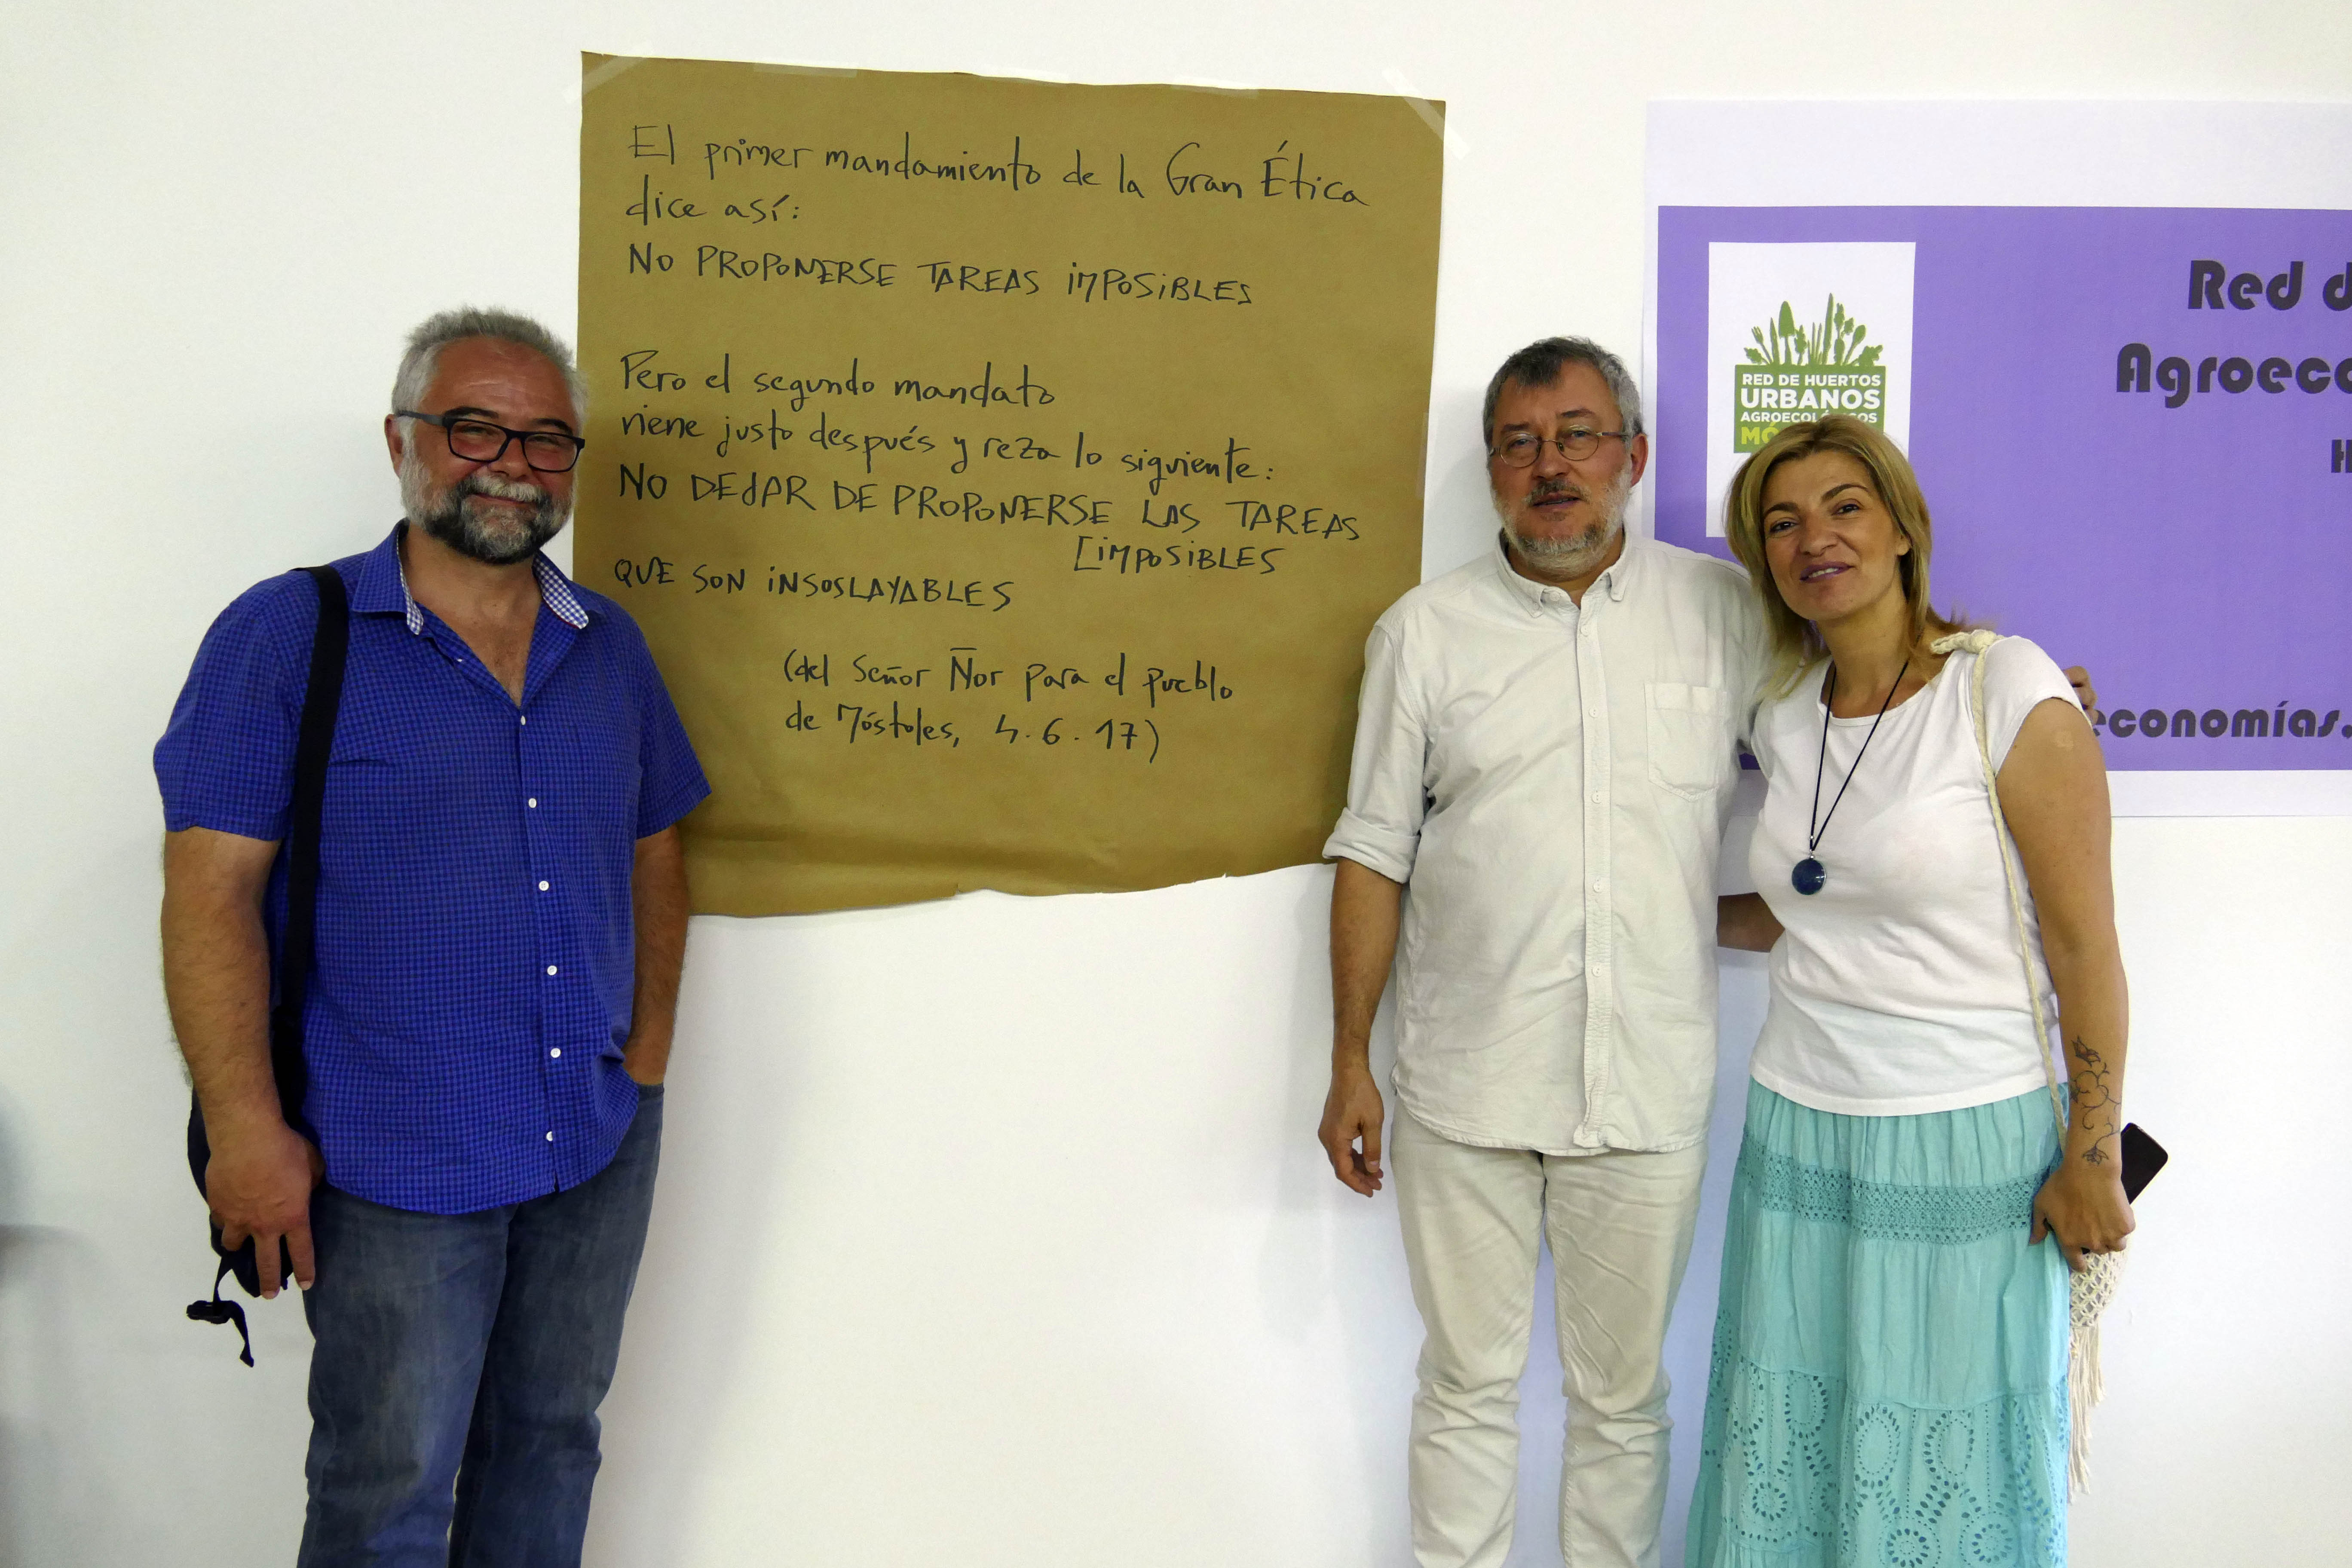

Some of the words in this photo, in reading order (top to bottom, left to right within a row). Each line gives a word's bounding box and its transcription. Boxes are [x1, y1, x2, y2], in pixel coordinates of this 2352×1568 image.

[628, 123, 675, 165] El
[704, 138, 814, 181] primer
[825, 131, 1041, 192] mandamiento
[1062, 149, 1102, 187] de
[1119, 153, 1145, 199] la
[1166, 141, 1243, 199] Gran
[1260, 139, 1370, 207] Ética
[625, 174, 706, 227] dice
[724, 194, 799, 224] así:
[629, 242, 674, 275] NO
[697, 245, 897, 288] PROPONERSE
[916, 261, 1040, 296] TAREAS
[2188, 260, 2304, 310] Red
[2322, 261, 2352, 311] d
[619, 349, 686, 392] Pero
[705, 352, 731, 394] el
[753, 357, 875, 413] segundo
[894, 361, 1055, 408] mandato
[1741, 388, 1880, 409] URBANOS
[1742, 374, 1774, 386] RED
[1778, 374, 1800, 386] DE
[1805, 374, 1881, 386] HUERTOS
[2116, 343, 2352, 409] Agroec
[1741, 410, 1877, 423] AGROECOLOS
[622, 404, 705, 439] viene
[716, 408, 793, 458] justo
[808, 411, 936, 475] después
[950, 436, 968, 475] y
[983, 437, 1062, 460] reza
[1075, 431, 1102, 469] lo
[1120, 437, 1274, 496] siguiente:
[619, 462, 668, 501] NO
[833, 480, 878, 513] DE
[893, 484, 1113, 527] PROPONERSE
[1141, 499, 1201, 534] LAS
[1225, 500, 1360, 541] TAREAS
[614, 556, 675, 588] QUE
[692, 564, 745, 594] SON
[783, 648, 829, 687] (del
[852, 653, 932, 688] Señor
[1025, 663, 1090, 703] para
[1104, 652, 1126, 696] el
[1142, 659, 1233, 709] pueblo
[785, 699, 821, 732] de
[837, 700, 960, 748] Móstoles,
